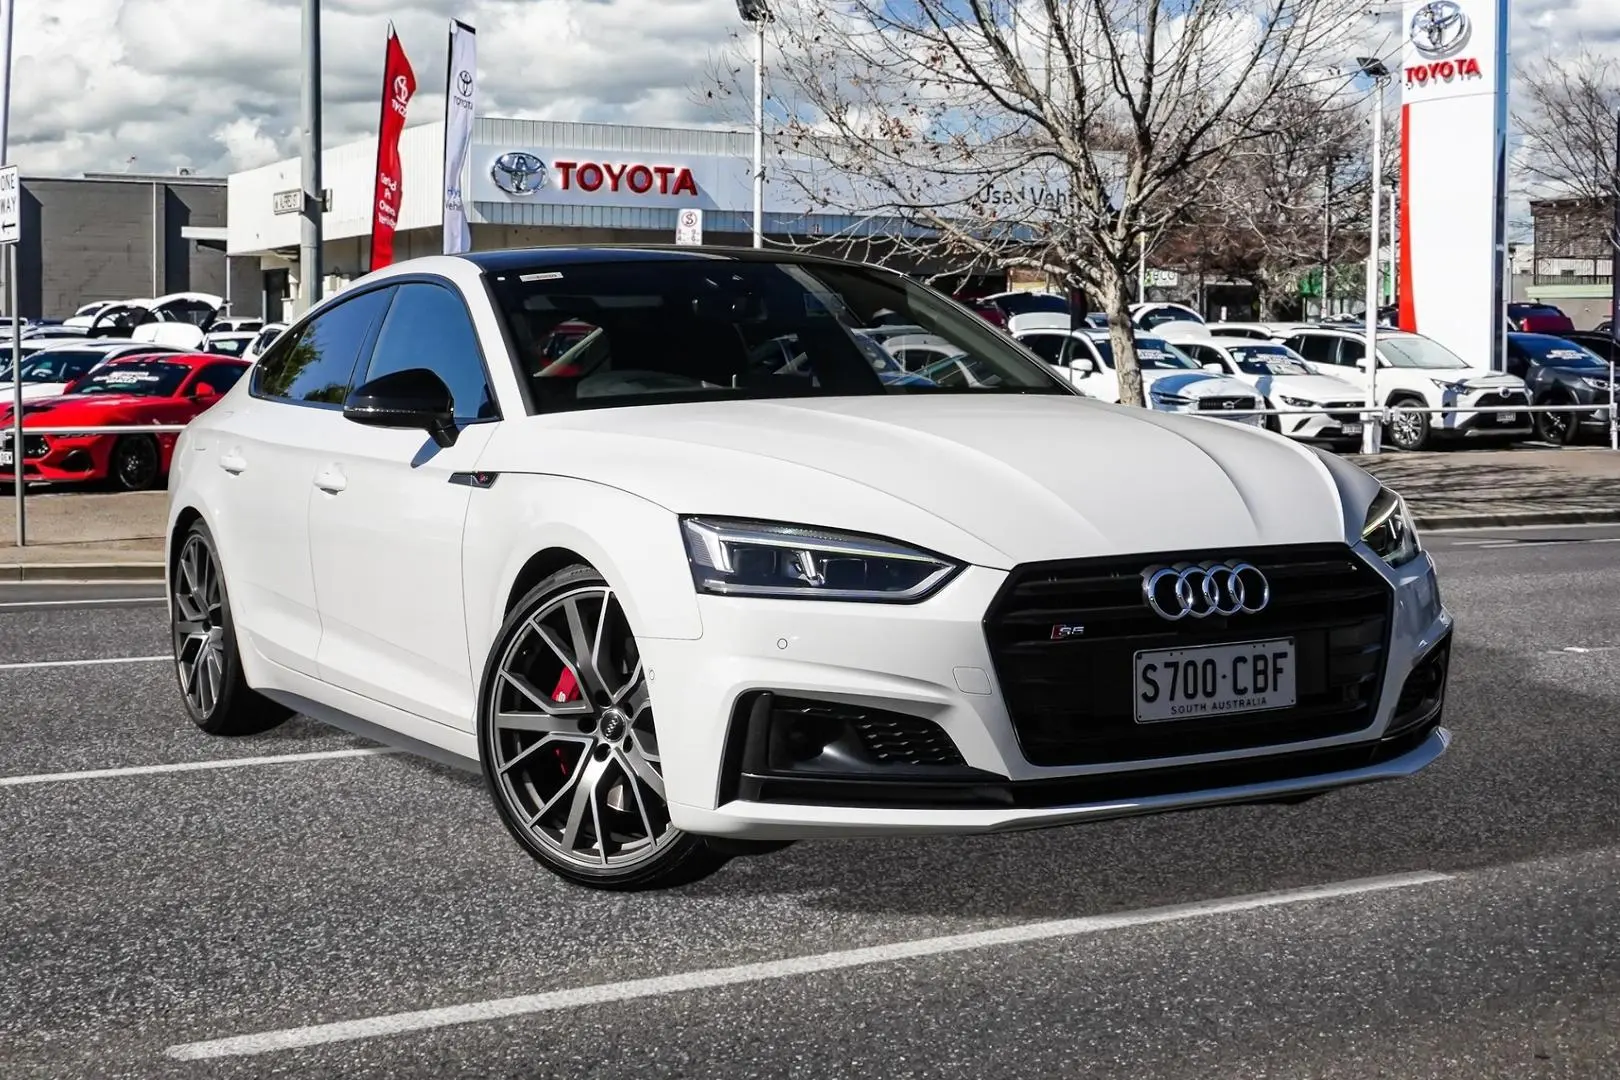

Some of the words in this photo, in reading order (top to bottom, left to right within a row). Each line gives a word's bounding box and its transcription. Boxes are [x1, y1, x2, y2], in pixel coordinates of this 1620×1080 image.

[1404, 58, 1481, 84] TOYOTA
[1, 174, 15, 190] ONE
[555, 162, 698, 195] TOYOTA
[0, 196, 16, 214] WAY
[1171, 704, 1207, 715] SOUTH
[1211, 697, 1267, 710] AUSTRALIA
